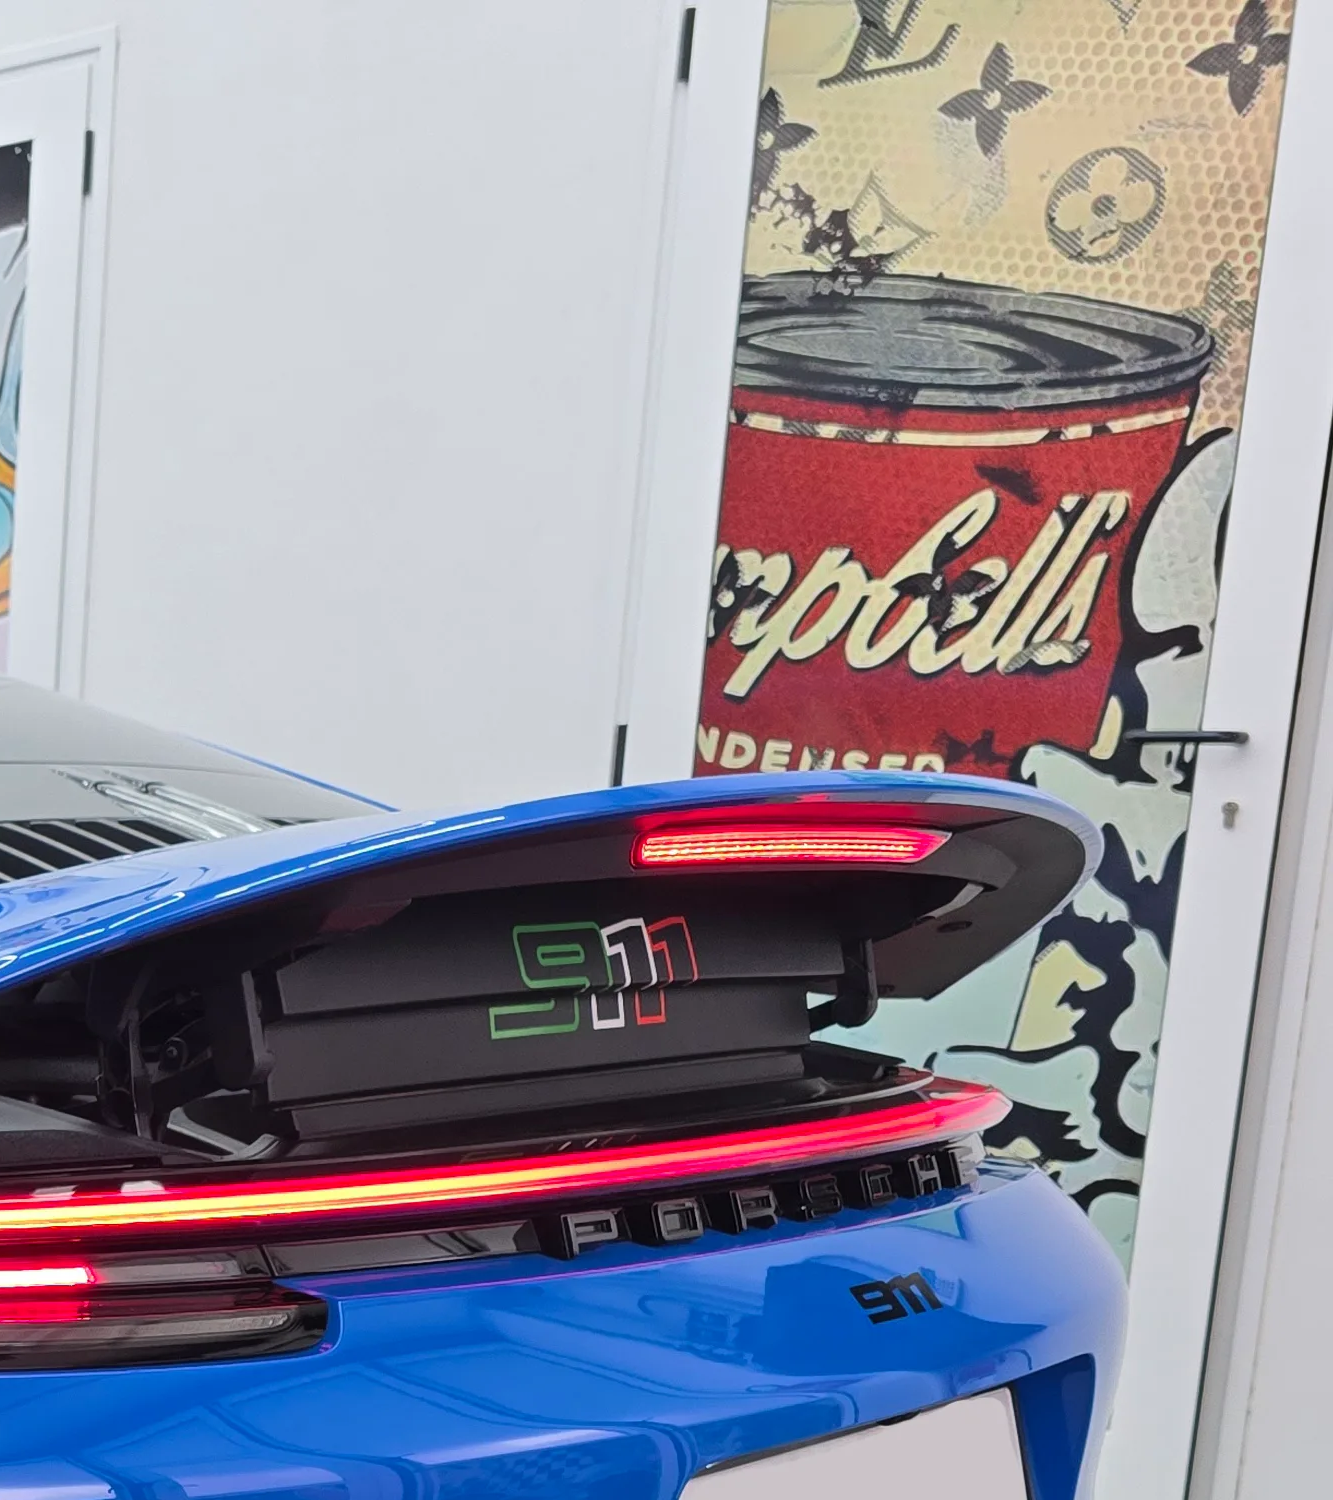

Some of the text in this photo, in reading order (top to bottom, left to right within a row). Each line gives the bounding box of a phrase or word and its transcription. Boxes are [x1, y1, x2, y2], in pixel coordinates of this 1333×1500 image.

[488, 916, 699, 1039] 911
[560, 1144, 980, 1259] PORSCHE
[850, 1272, 944, 1325] 911
